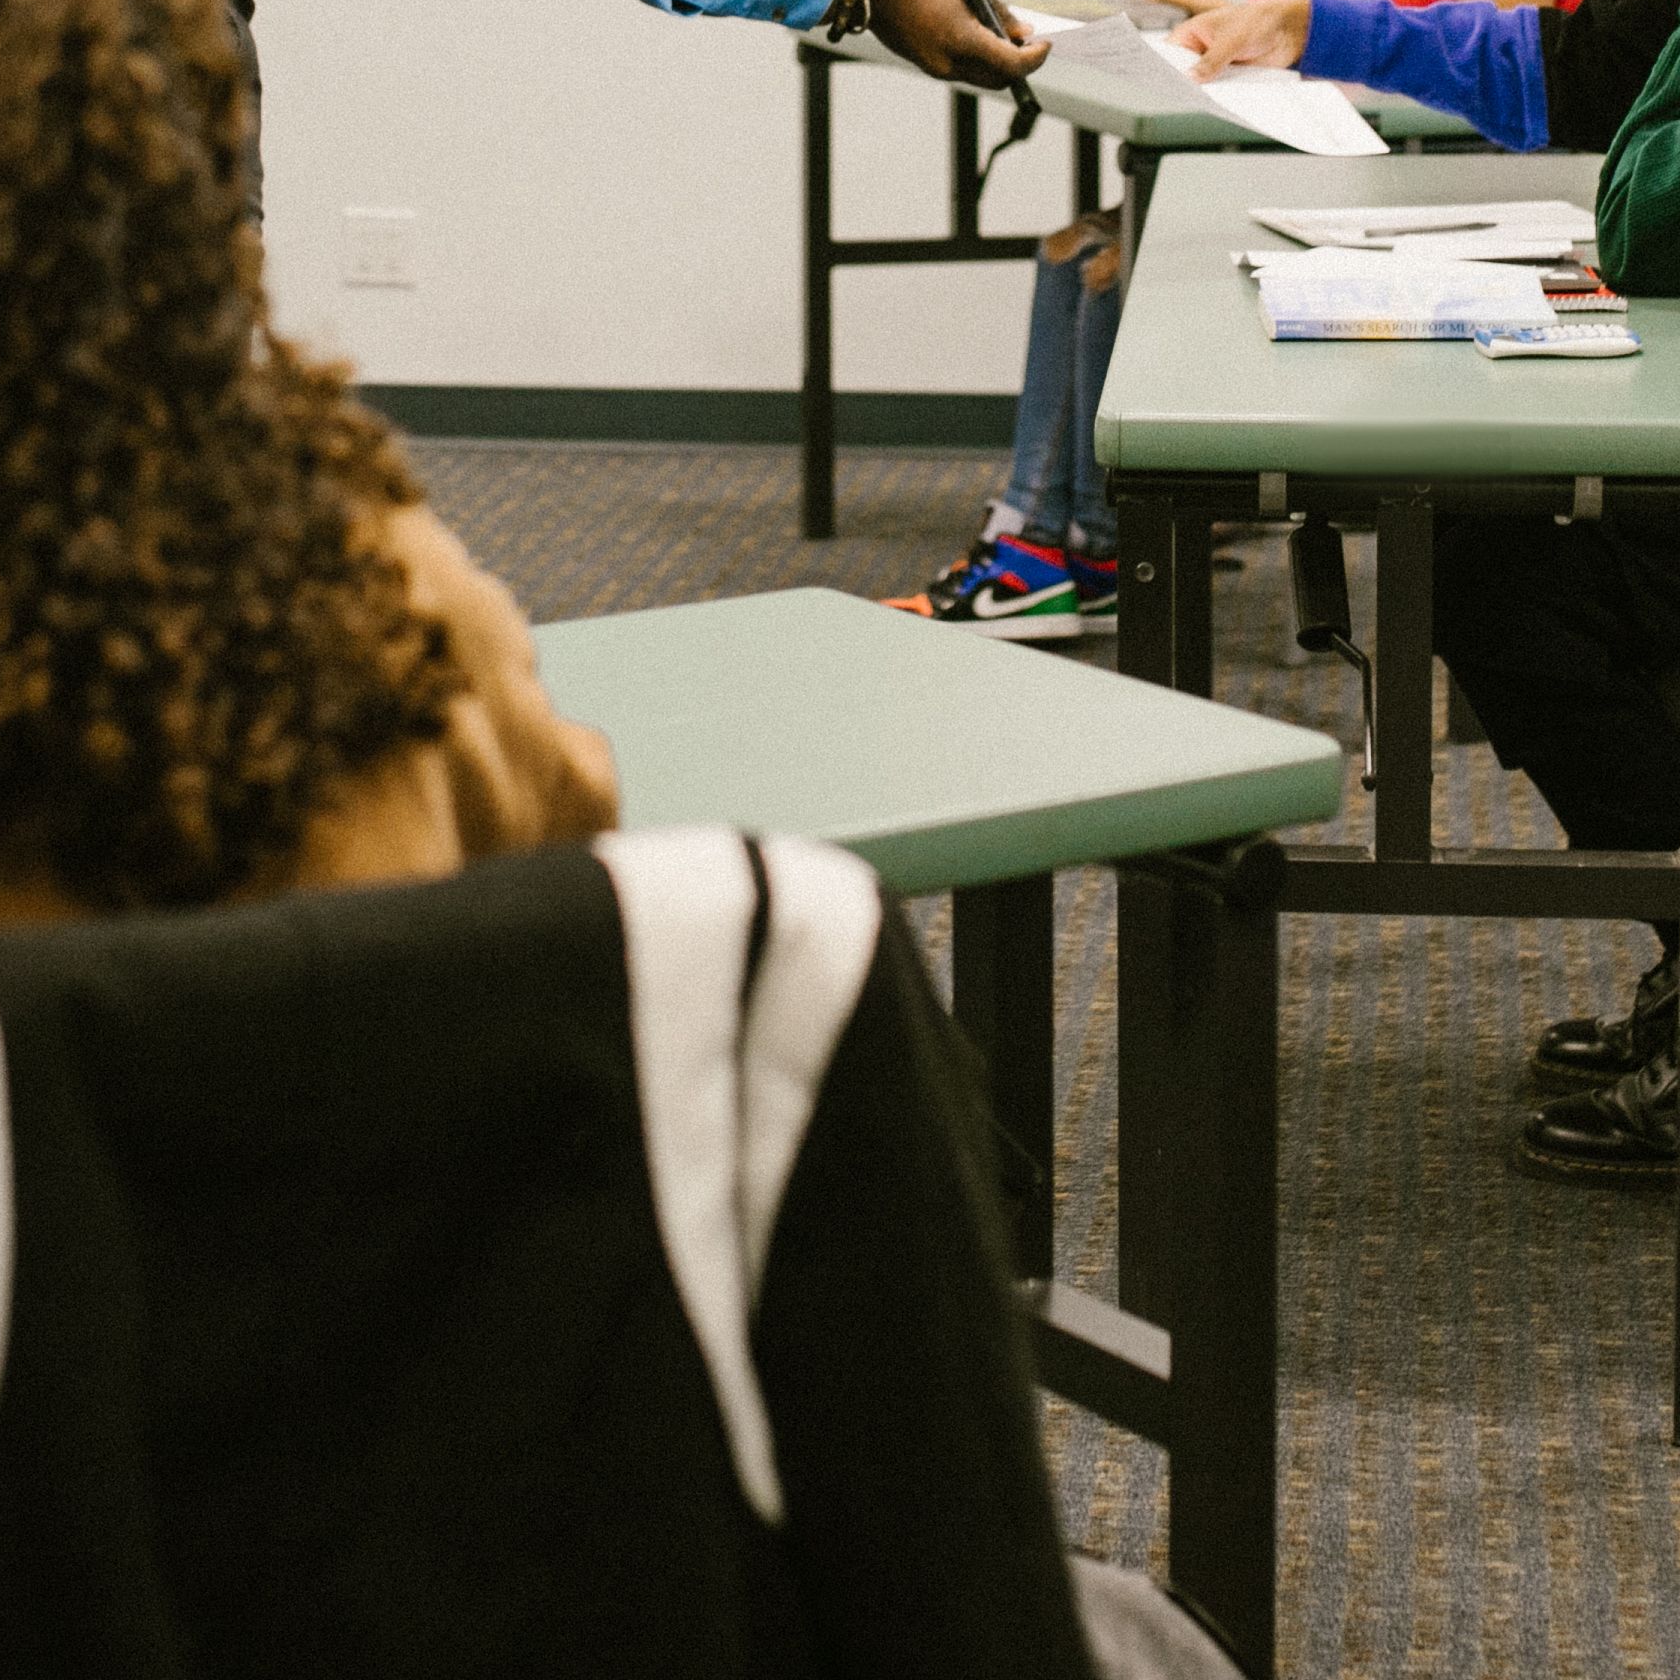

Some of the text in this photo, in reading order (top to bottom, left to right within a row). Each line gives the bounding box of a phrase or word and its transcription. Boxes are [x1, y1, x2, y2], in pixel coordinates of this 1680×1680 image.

[1322, 322, 1365, 334] MAN'S
[1367, 322, 1418, 334] SEARCH
[1422, 322, 1446, 334] FOR
